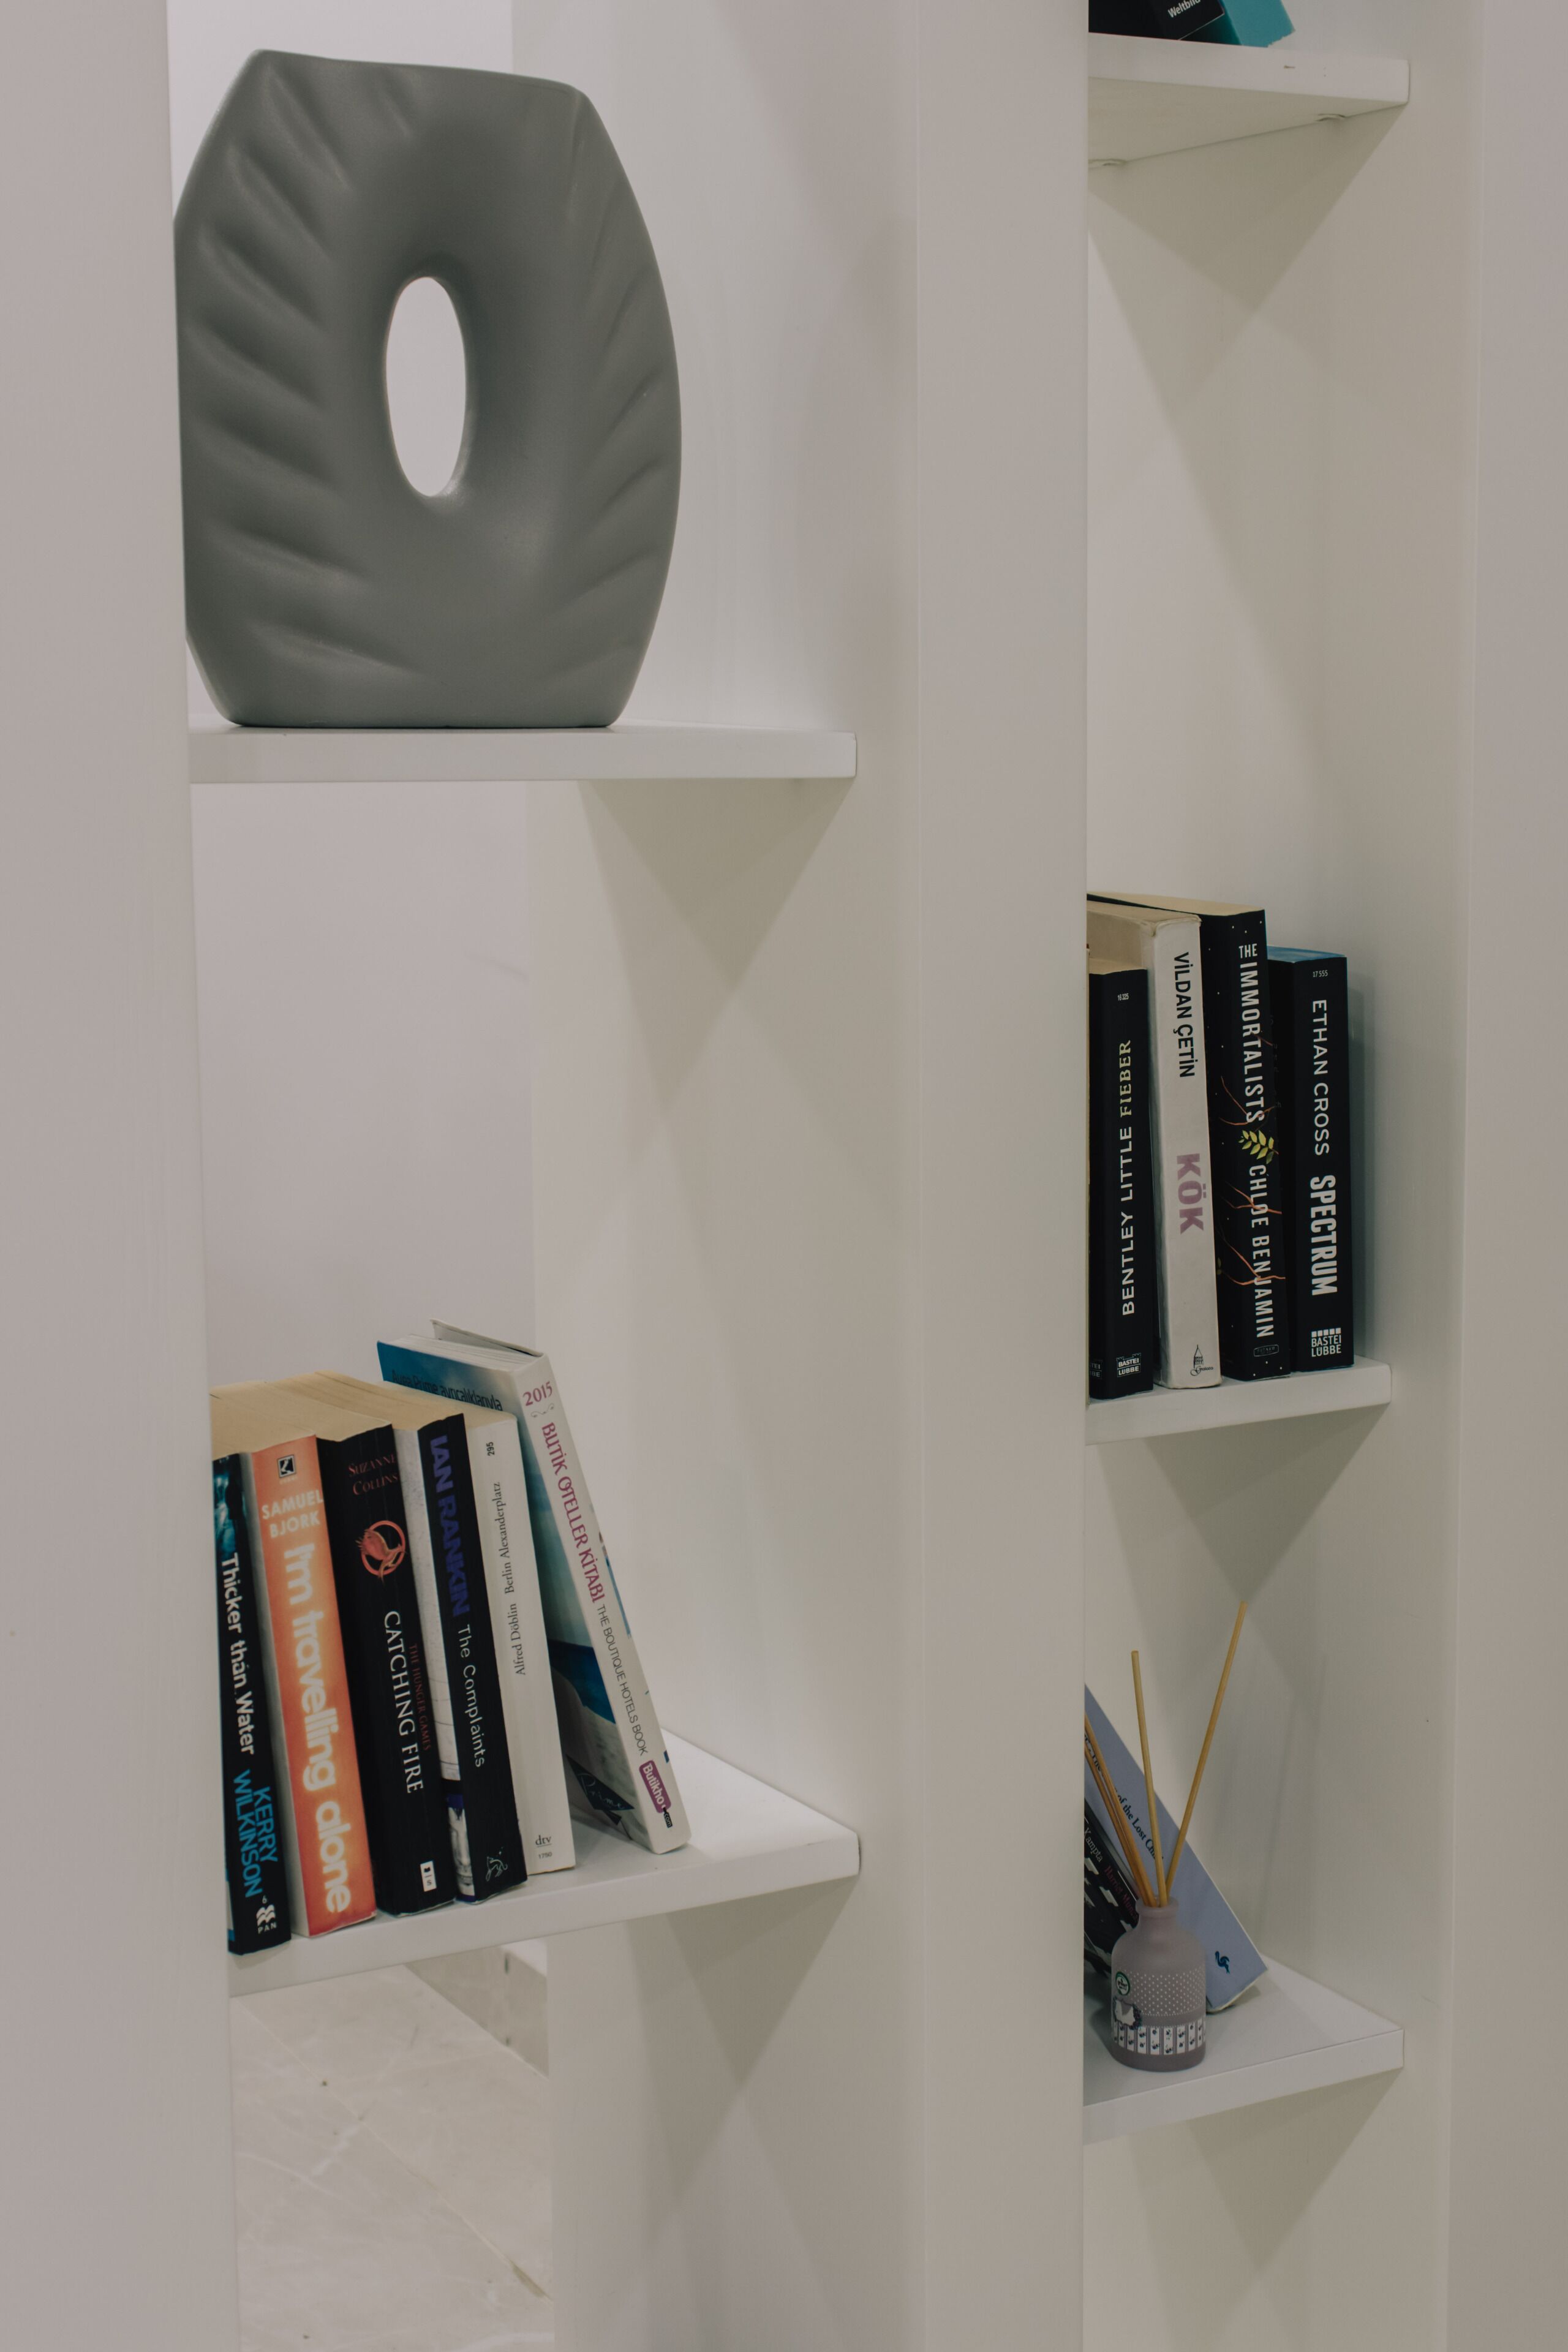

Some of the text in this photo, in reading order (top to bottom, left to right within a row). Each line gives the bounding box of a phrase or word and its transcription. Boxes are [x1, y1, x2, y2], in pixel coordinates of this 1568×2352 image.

[1238, 943, 1258, 959] THE
[1173, 951, 1199, 1078] VİLDAN ÇETİN
[1240, 962, 1265, 1124] IMMORTALISTS
[1312, 999, 1330, 1156] ETHAN CROSS
[1119, 1039, 1134, 1316] BENTLEY LITTLE FIEBER
[1176, 1153, 1207, 1235] KÖK
[1249, 1164, 1269, 1229] CHLOE
[1310, 1174, 1338, 1297] SPECTRUM
[1252, 1234, 1275, 1338] BENJAMIN
[1118, 1357, 1139, 1368] BASTEI
[1311, 1334, 1342, 1348] BASTEI
[1311, 1344, 1342, 1357] LÜBBE
[522, 1380, 553, 1408] 2015
[347, 1453, 398, 1477] SUZANNE
[352, 1472, 400, 1496] COLLINS
[486, 1441, 495, 1456] 295
[262, 1489, 324, 1520] SAMUEL
[430, 1435, 471, 1617] IAN RANKIN
[541, 1422, 605, 1603] BUTİK OTELLER KİTABI
[492, 1482, 526, 1676] Alfred Döblin Berlin Alexanderplatz
[221, 1553, 255, 1755] Thicker than Water
[412, 1666, 427, 1714] HUNGER
[597, 1604, 648, 1756] THE BOUTIQUE HOTELS BOOK
[284, 1543, 352, 1913] I'm travelling alone
[384, 1610, 424, 1794] CATCHING FIRE
[418, 1714, 432, 1752] GAMES
[457, 1623, 485, 1769] The Complaints
[233, 1768, 263, 1899] WILKINSON
[253, 1786, 279, 1863] KERRY
[535, 1834, 552, 1845] dtv
[1123, 1805, 1133, 1820] the
[1132, 1817, 1146, 1840] Lost
[257, 1921, 277, 1935] PAN
